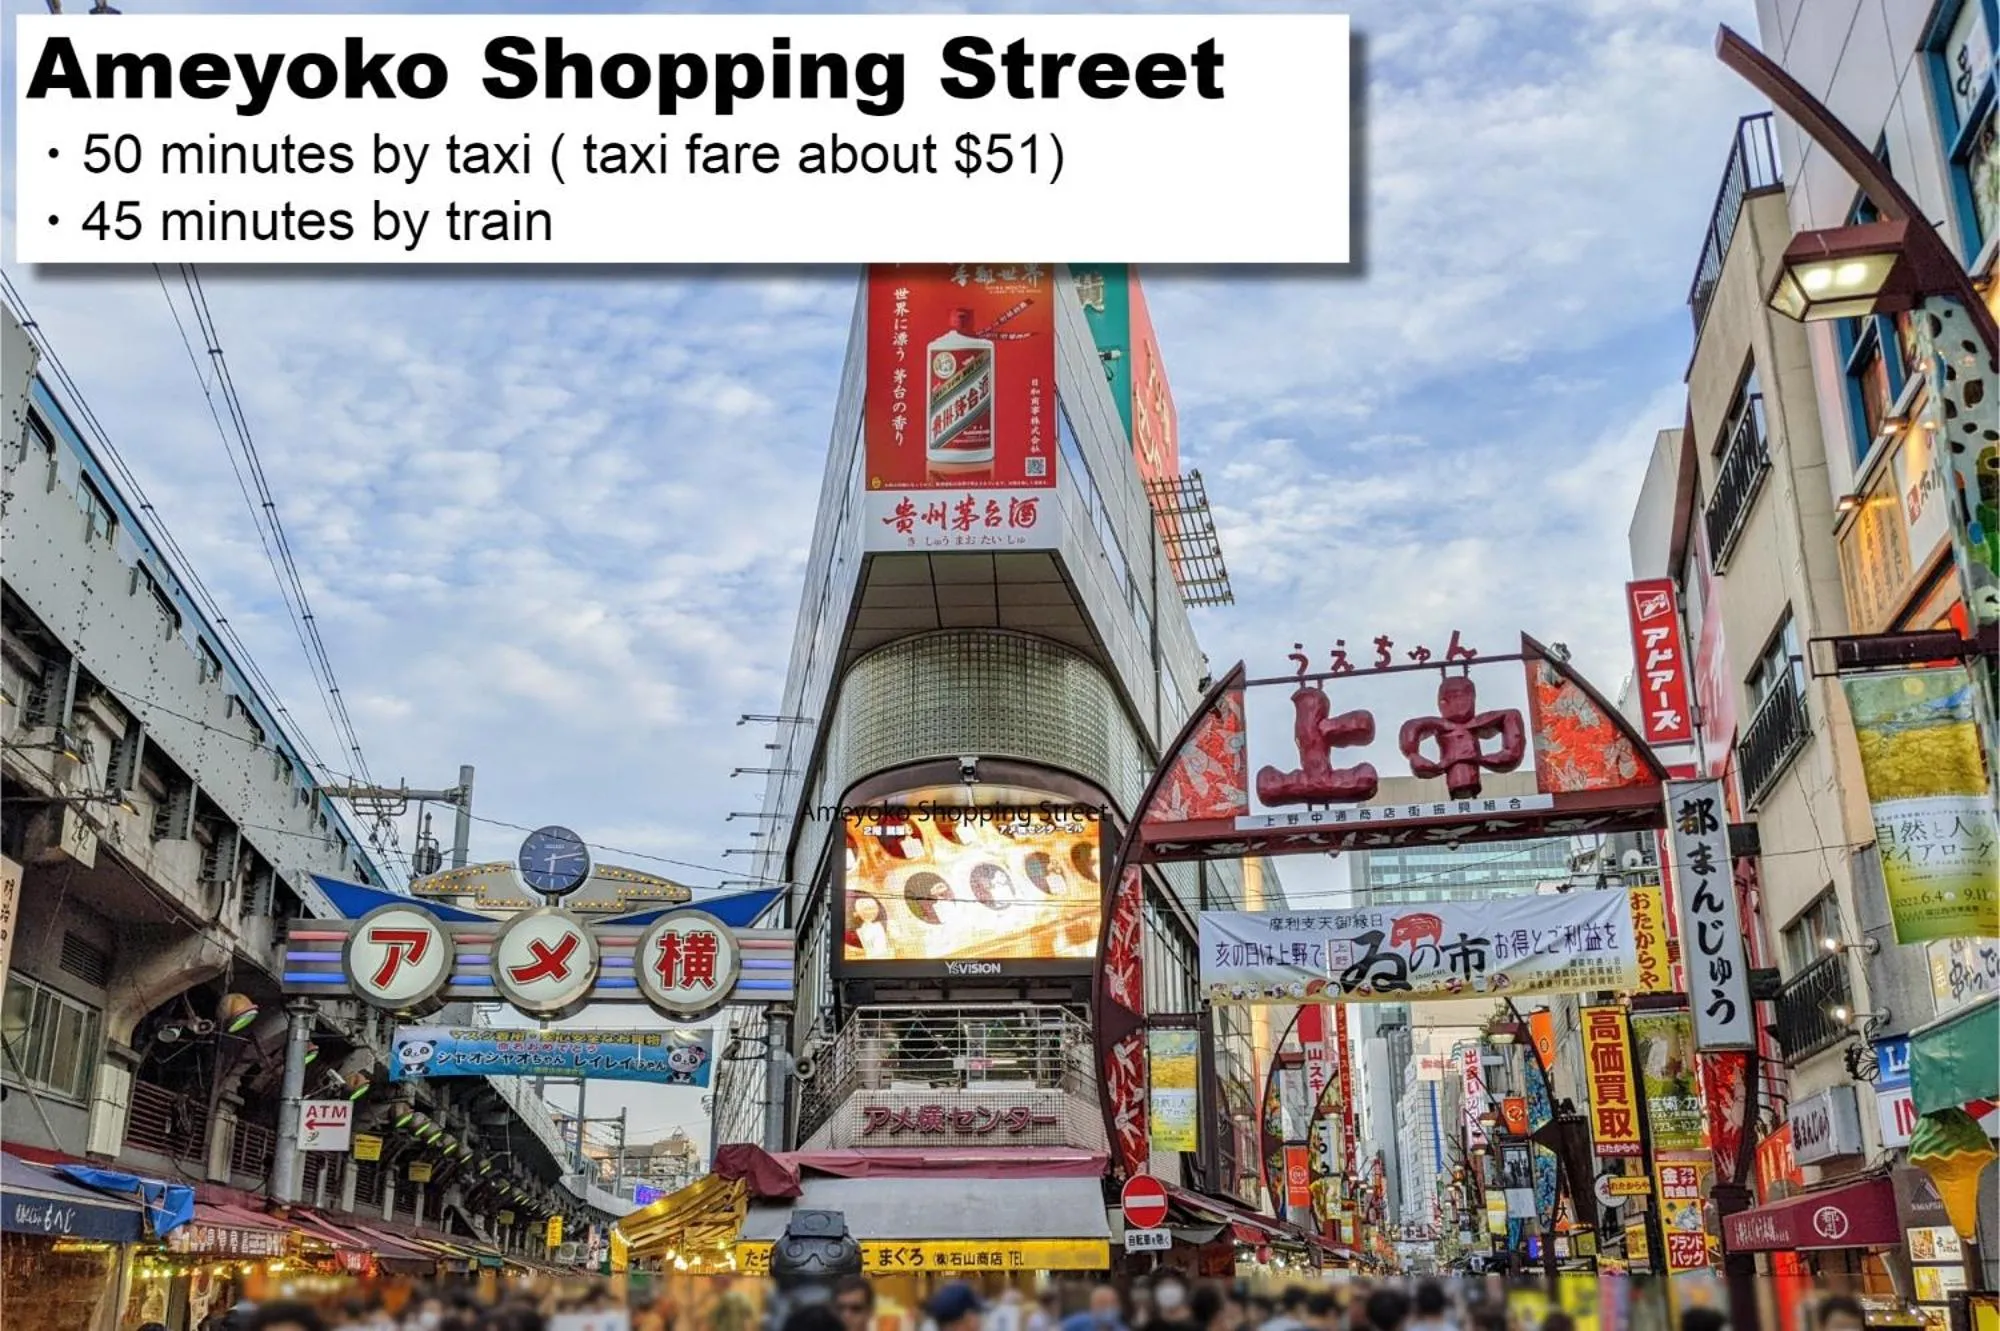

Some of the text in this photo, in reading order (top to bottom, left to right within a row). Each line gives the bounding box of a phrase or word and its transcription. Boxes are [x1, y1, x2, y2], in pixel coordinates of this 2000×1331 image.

[883, 493, 1039, 534] 貴州茅台酒
[1642, 626, 1682, 732] アドアーズ
[1256, 675, 1526, 808] 上中
[1674, 797, 1736, 1026] 都まんじゅう
[368, 927, 719, 992] アメ横
[1494, 921, 1619, 959] お得とご利益を
[1631, 892, 1660, 989] おたからや
[1587, 1010, 1633, 1139] 高価買取
[306, 1105, 347, 1118] ATM
[863, 1104, 1057, 1136] アメ横センター
[1662, 1167, 1678, 1184] 金
[879, 1247, 924, 1266] まぐろ
[1008, 1251, 1024, 1265] TEL
[1669, 1235, 1704, 1250] ブランド
[1672, 1250, 1704, 1266] バッグ
